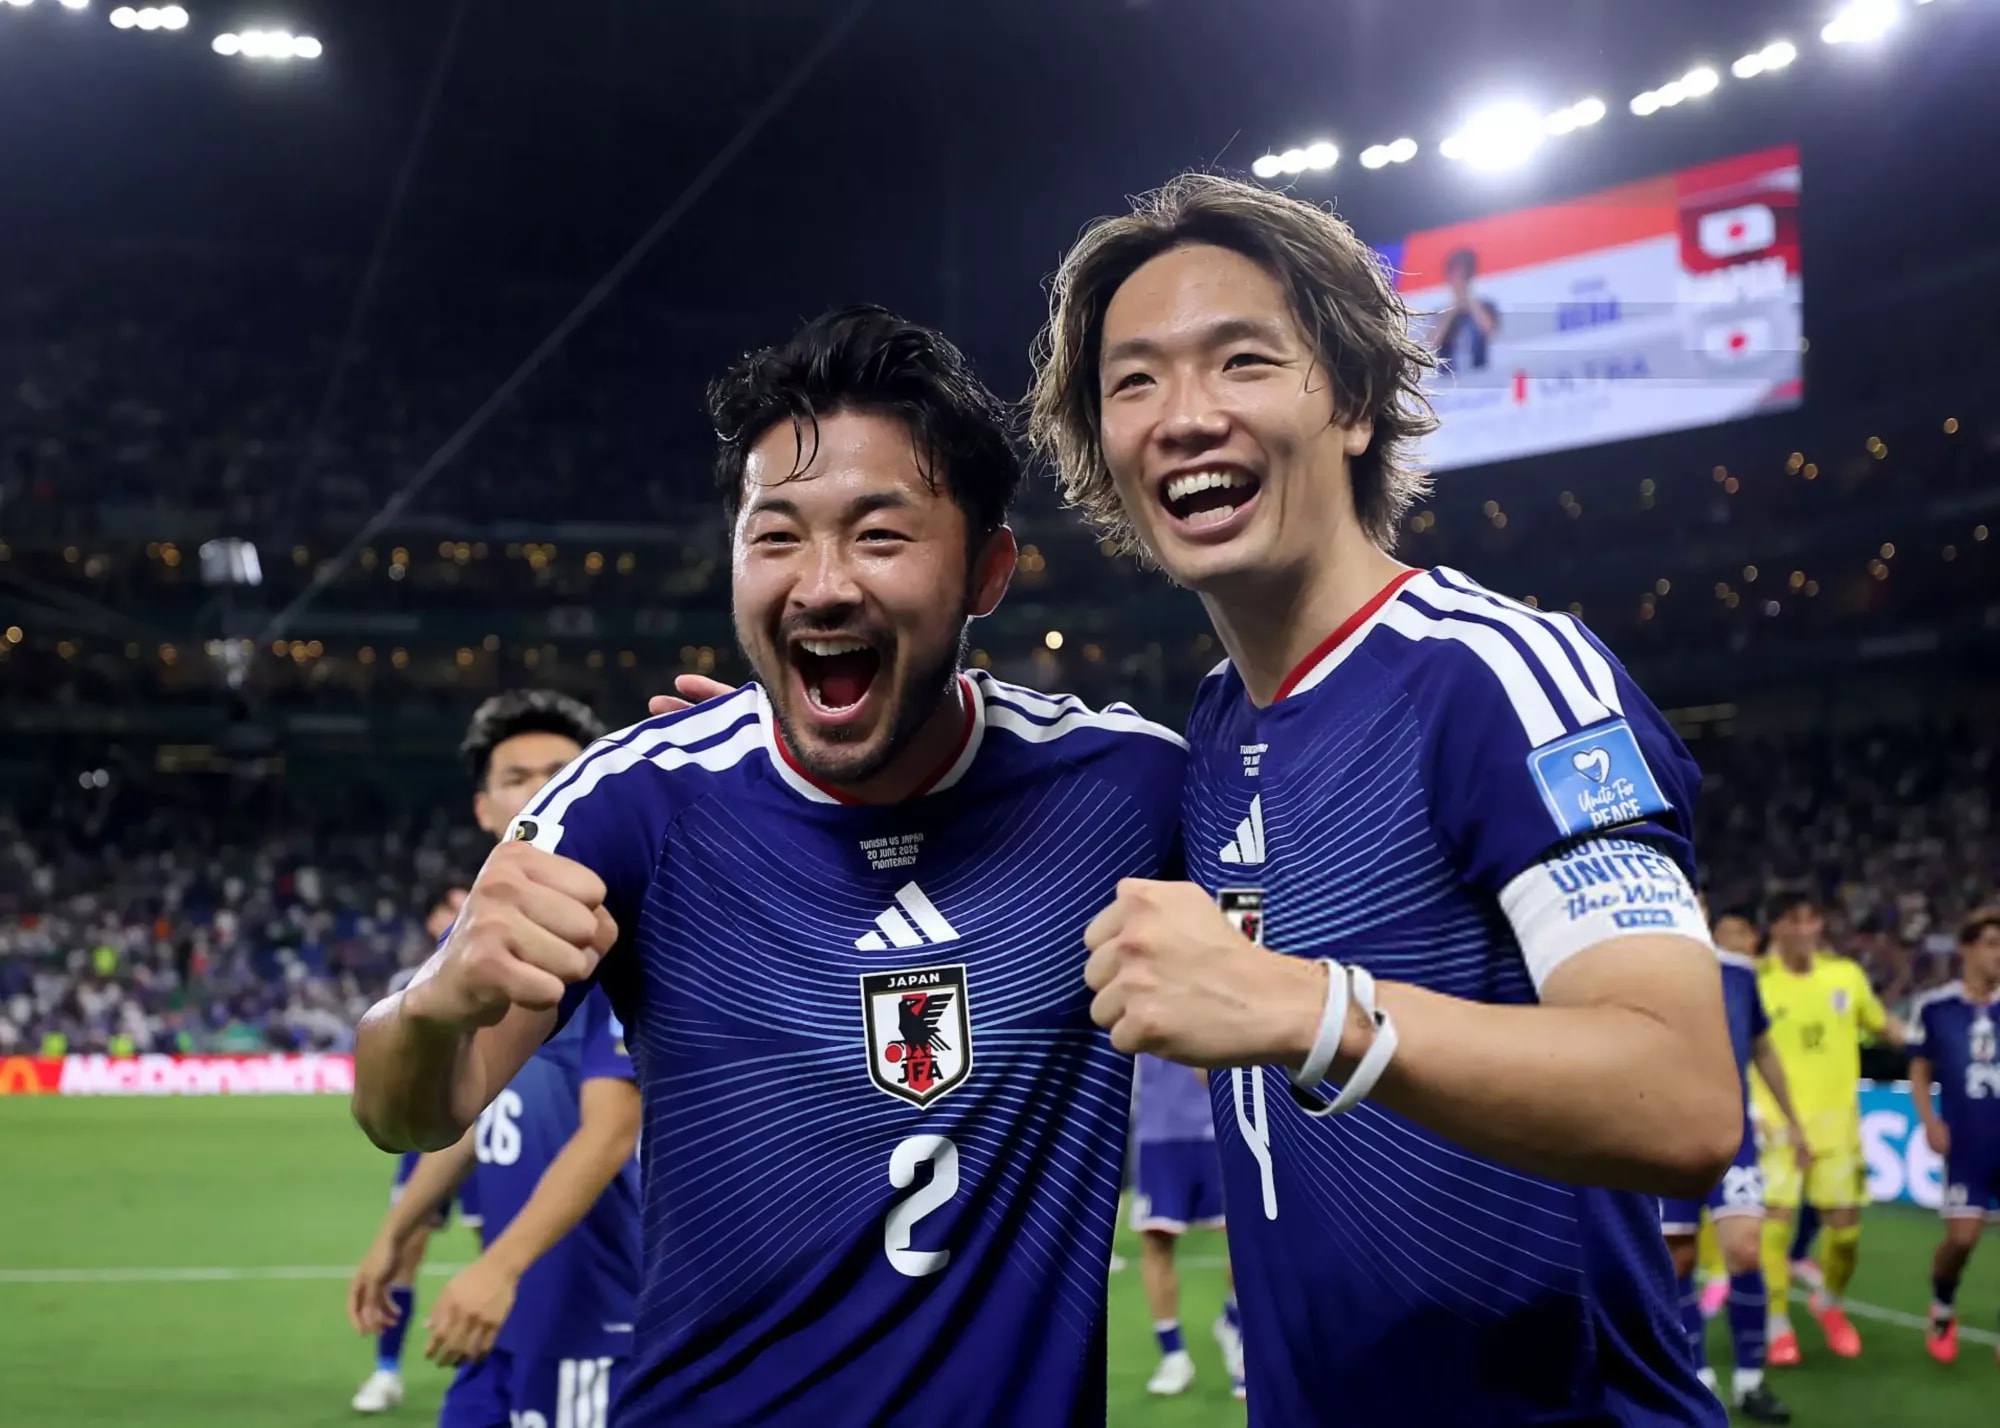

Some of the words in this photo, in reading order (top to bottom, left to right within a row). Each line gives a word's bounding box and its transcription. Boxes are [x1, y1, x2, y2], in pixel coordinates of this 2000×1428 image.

[1578, 785, 1616, 812] Unite
[1612, 778, 1635, 796] For
[1590, 799, 1642, 828] PEACE
[860, 838, 887, 850] TUNISIA
[901, 832, 924, 845] JAPAN
[867, 850, 878, 860] 20
[880, 847, 897, 858] JUNE
[872, 856, 916, 870] MONTERREY
[887, 972, 941, 988] JAPAN
[897, 1060, 944, 1083] JFA
[475, 1088, 523, 1166] 26
[885, 1134, 959, 1277] 2
